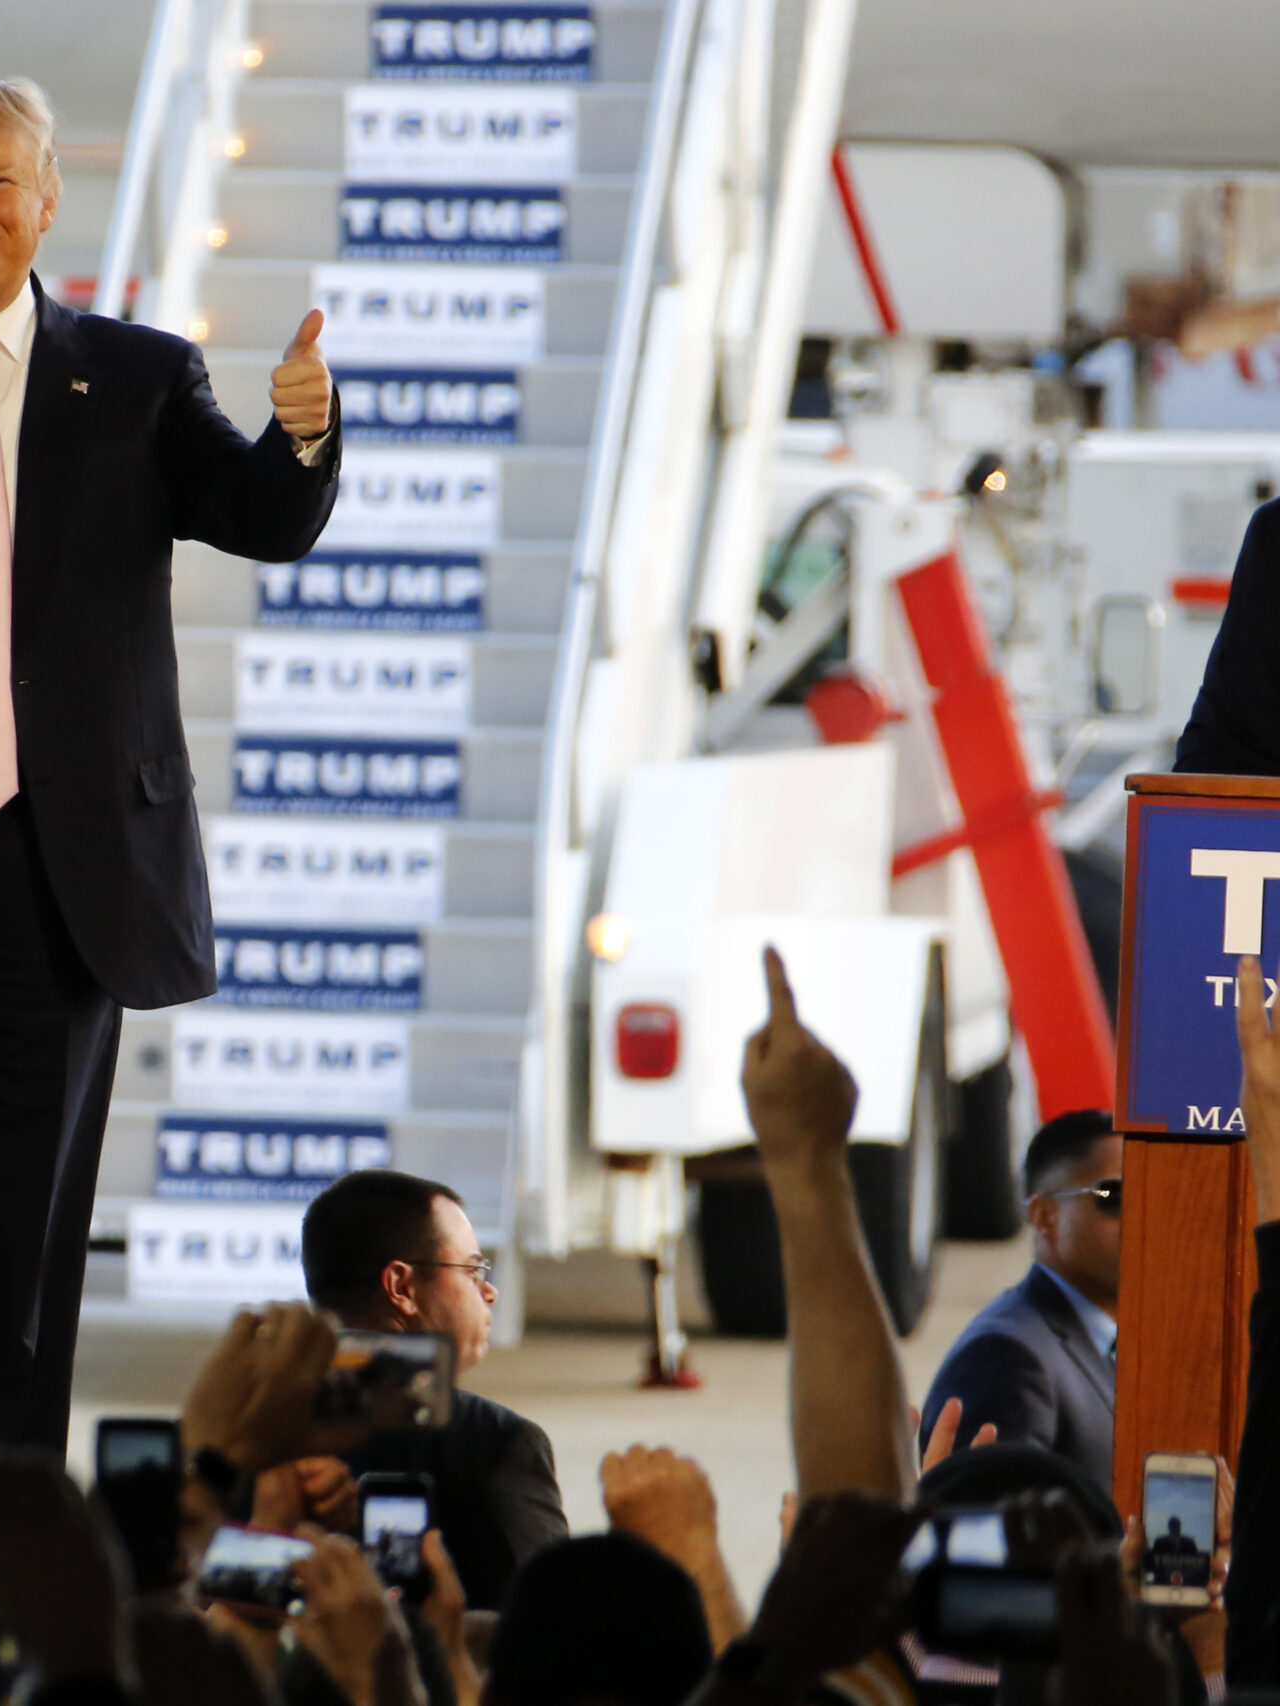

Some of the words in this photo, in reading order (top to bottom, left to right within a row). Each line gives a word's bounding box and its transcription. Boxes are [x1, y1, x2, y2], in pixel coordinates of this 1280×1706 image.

[374, 18, 595, 61] TRUMP
[353, 109, 570, 143] TRUMP
[341, 198, 567, 241] TRUMP
[323, 288, 538, 322] TRUMP
[340, 380, 519, 425] RUMP
[338, 477, 487, 506] UMP
[257, 563, 485, 609] TRUMP
[246, 656, 465, 692] TRUMP
[235, 749, 462, 797] TRUMP
[217, 840, 436, 878] TRUMP
[176, 1035, 403, 1072] TRUMP
[157, 1129, 391, 1177] TRUMP
[139, 1228, 302, 1267] TRUM
